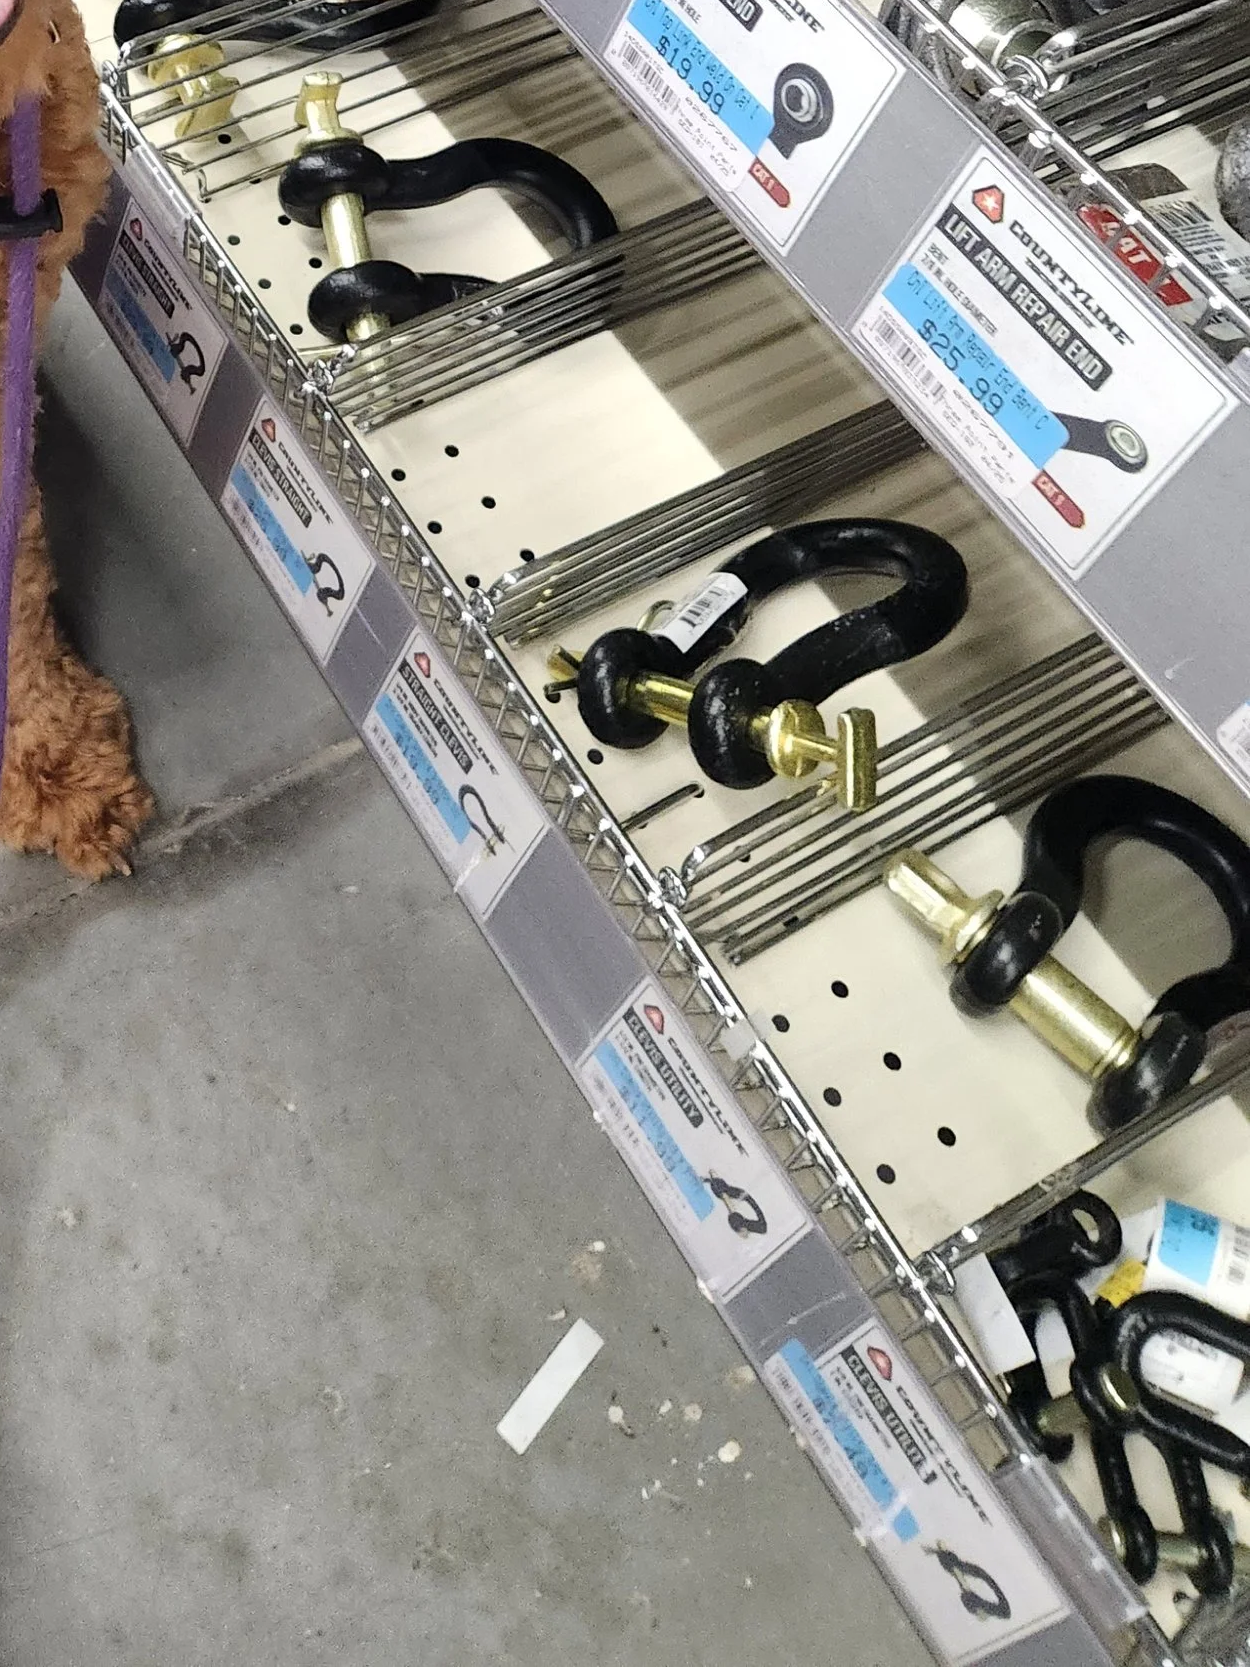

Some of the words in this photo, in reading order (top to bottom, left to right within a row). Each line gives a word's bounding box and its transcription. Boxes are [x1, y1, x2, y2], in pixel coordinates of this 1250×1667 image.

[654, 32, 727, 118] $19.99
[752, 162, 769, 185] CAT
[765, 177, 775, 190] 1
[942, 211, 982, 256] LIFT
[976, 246, 1018, 293] ARM
[1009, 281, 1072, 349] REPAIR
[1063, 337, 1105, 382] END
[1006, 218, 1136, 350] COUNTYLINE
[914, 315, 1007, 418] $25.99
[993, 366, 1018, 396] End
[251, 432, 276, 473] CLEVIS
[273, 465, 308, 522] STRAIGHT
[1037, 474, 1059, 500] CAT
[401, 663, 442, 726] STRAIGHT
[439, 721, 469, 767] CLEVIS
[627, 1013, 663, 1066] CLEVIS
[658, 1061, 700, 1122] UTILITY
[845, 1354, 889, 1411] CLEVIS
